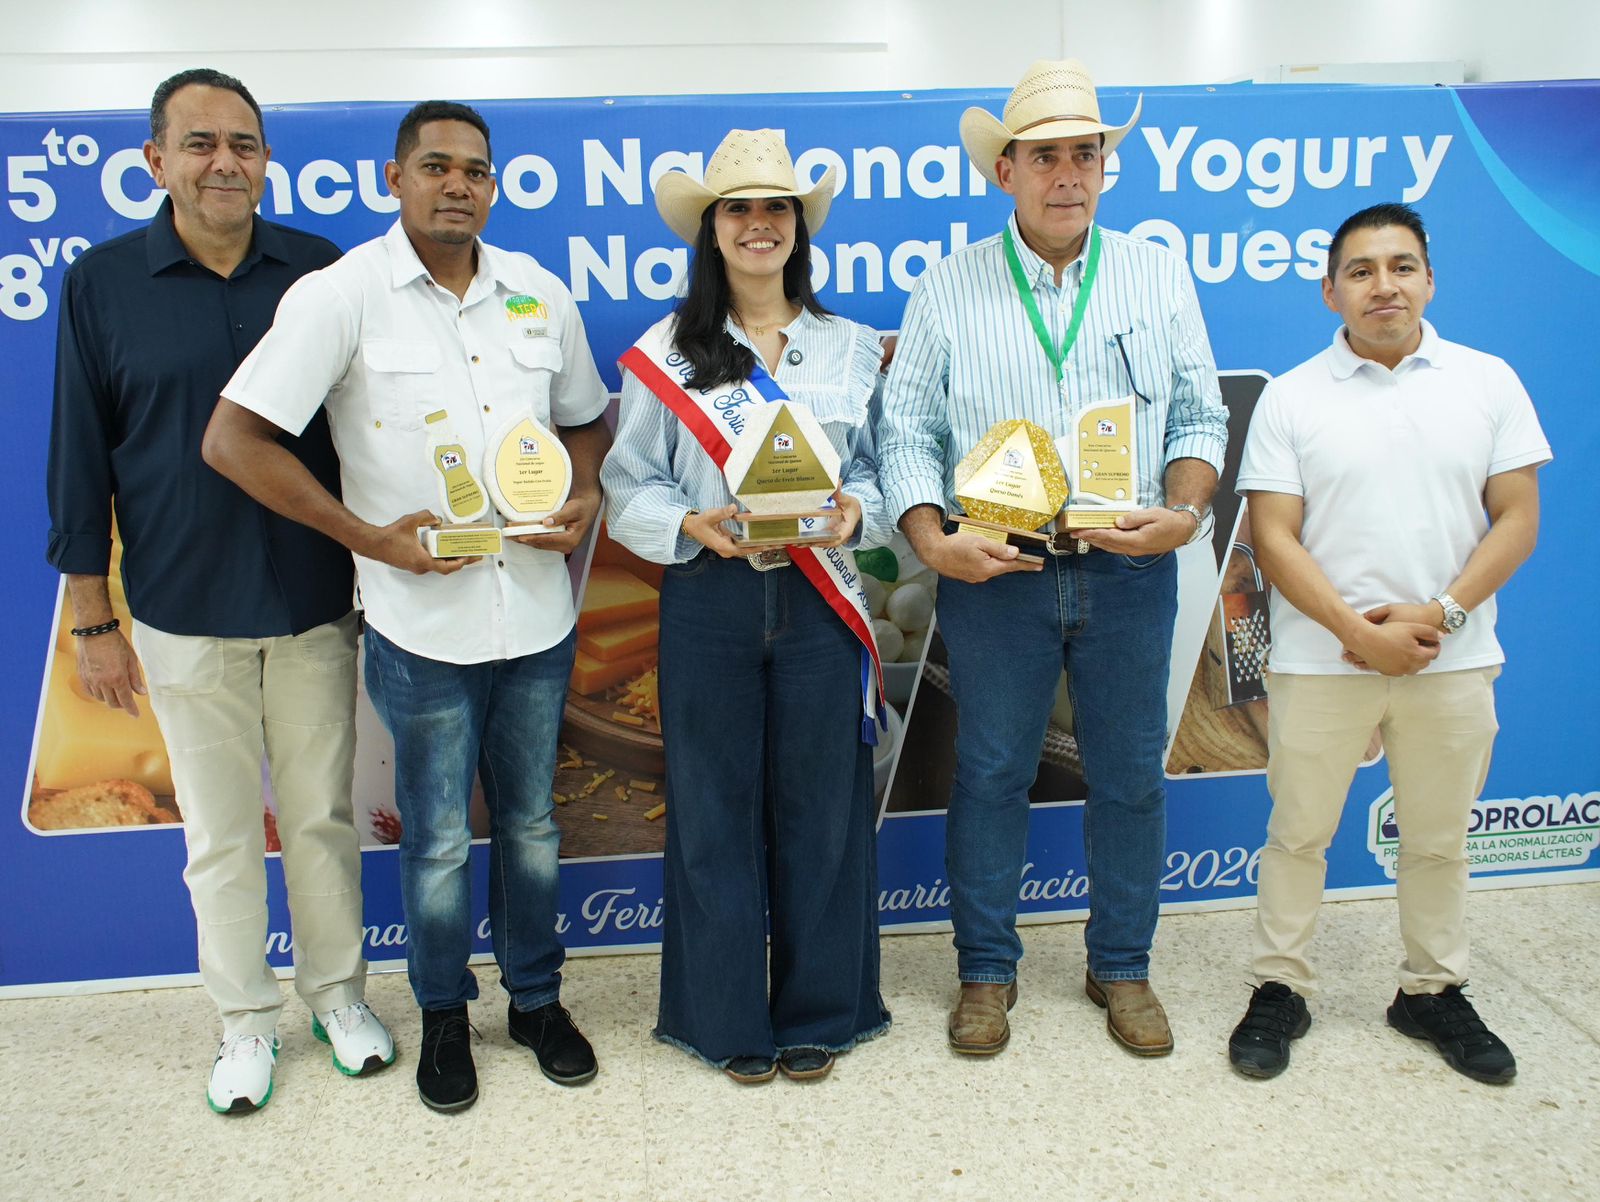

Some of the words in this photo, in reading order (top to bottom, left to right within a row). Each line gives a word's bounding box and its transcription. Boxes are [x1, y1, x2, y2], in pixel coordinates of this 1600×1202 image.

[8, 128, 99, 222] 5to
[101, 148, 557, 219] Cncuo
[583, 129, 986, 207] Naona
[1141, 126, 1387, 208] Yogur
[1402, 135, 1453, 203] y
[713, 388, 756, 435] Feria
[823, 547, 855, 589] acional
[1468, 851, 1530, 865] ESADORAS
[1532, 847, 1583, 860] LÁCTEAS
[1482, 840, 1496, 850] LA
[1499, 831, 1593, 849] NORMALIZACIÓN
[581, 887, 664, 935] Feri
[1159, 846, 1264, 891] 2026
